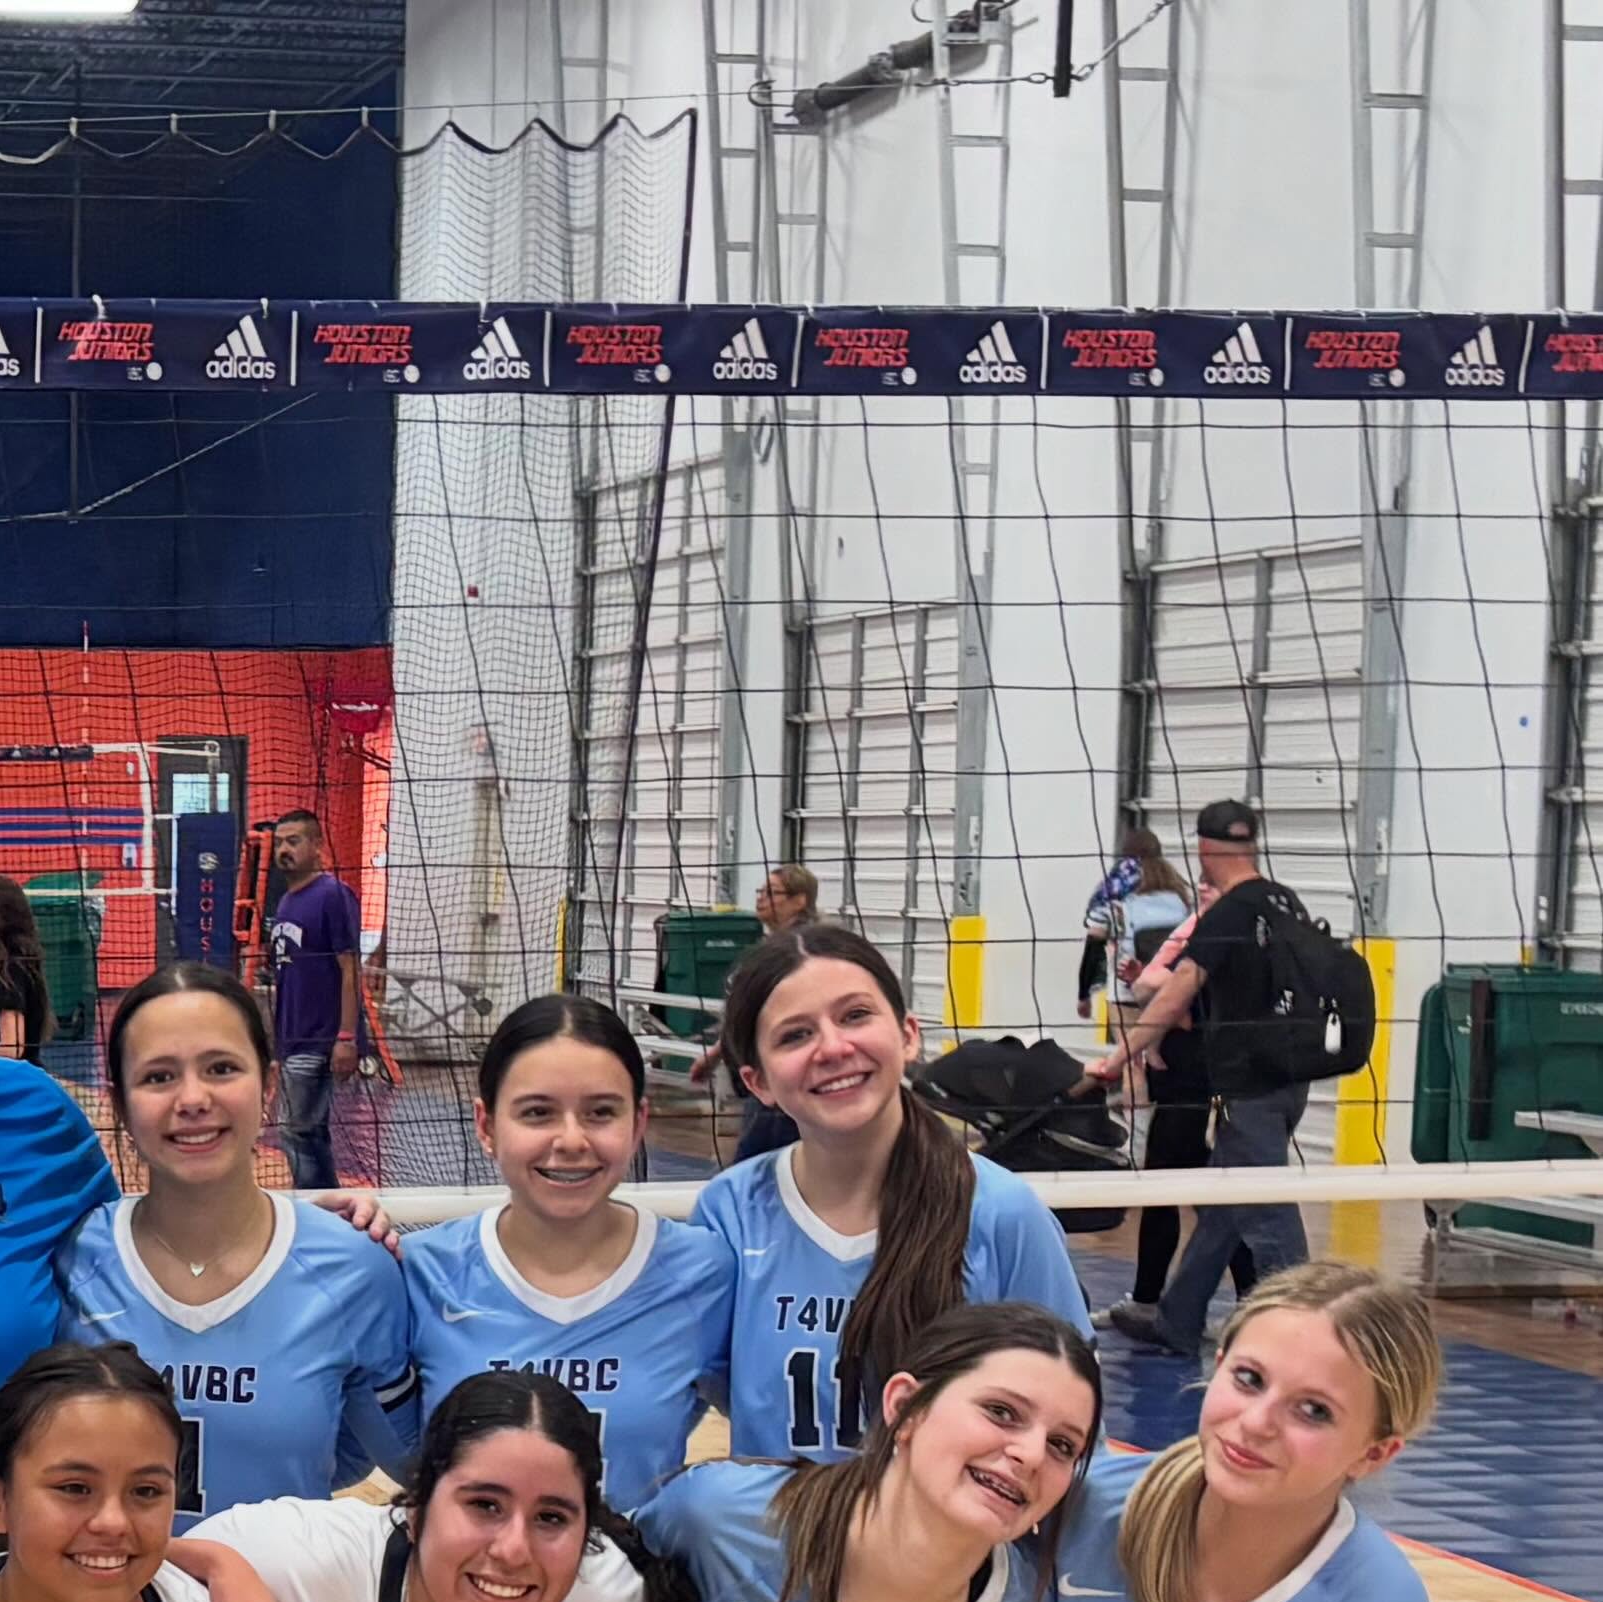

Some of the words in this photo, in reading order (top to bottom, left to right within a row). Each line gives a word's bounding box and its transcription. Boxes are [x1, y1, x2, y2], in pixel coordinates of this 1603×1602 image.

[206, 355, 276, 379] adidas
[463, 357, 531, 380] adidas
[713, 357, 778, 380] adidas
[959, 362, 1027, 383] adidas
[1203, 362, 1271, 384] adidas
[200, 878, 214, 960] HOUS
[775, 1294, 856, 1335] T4V
